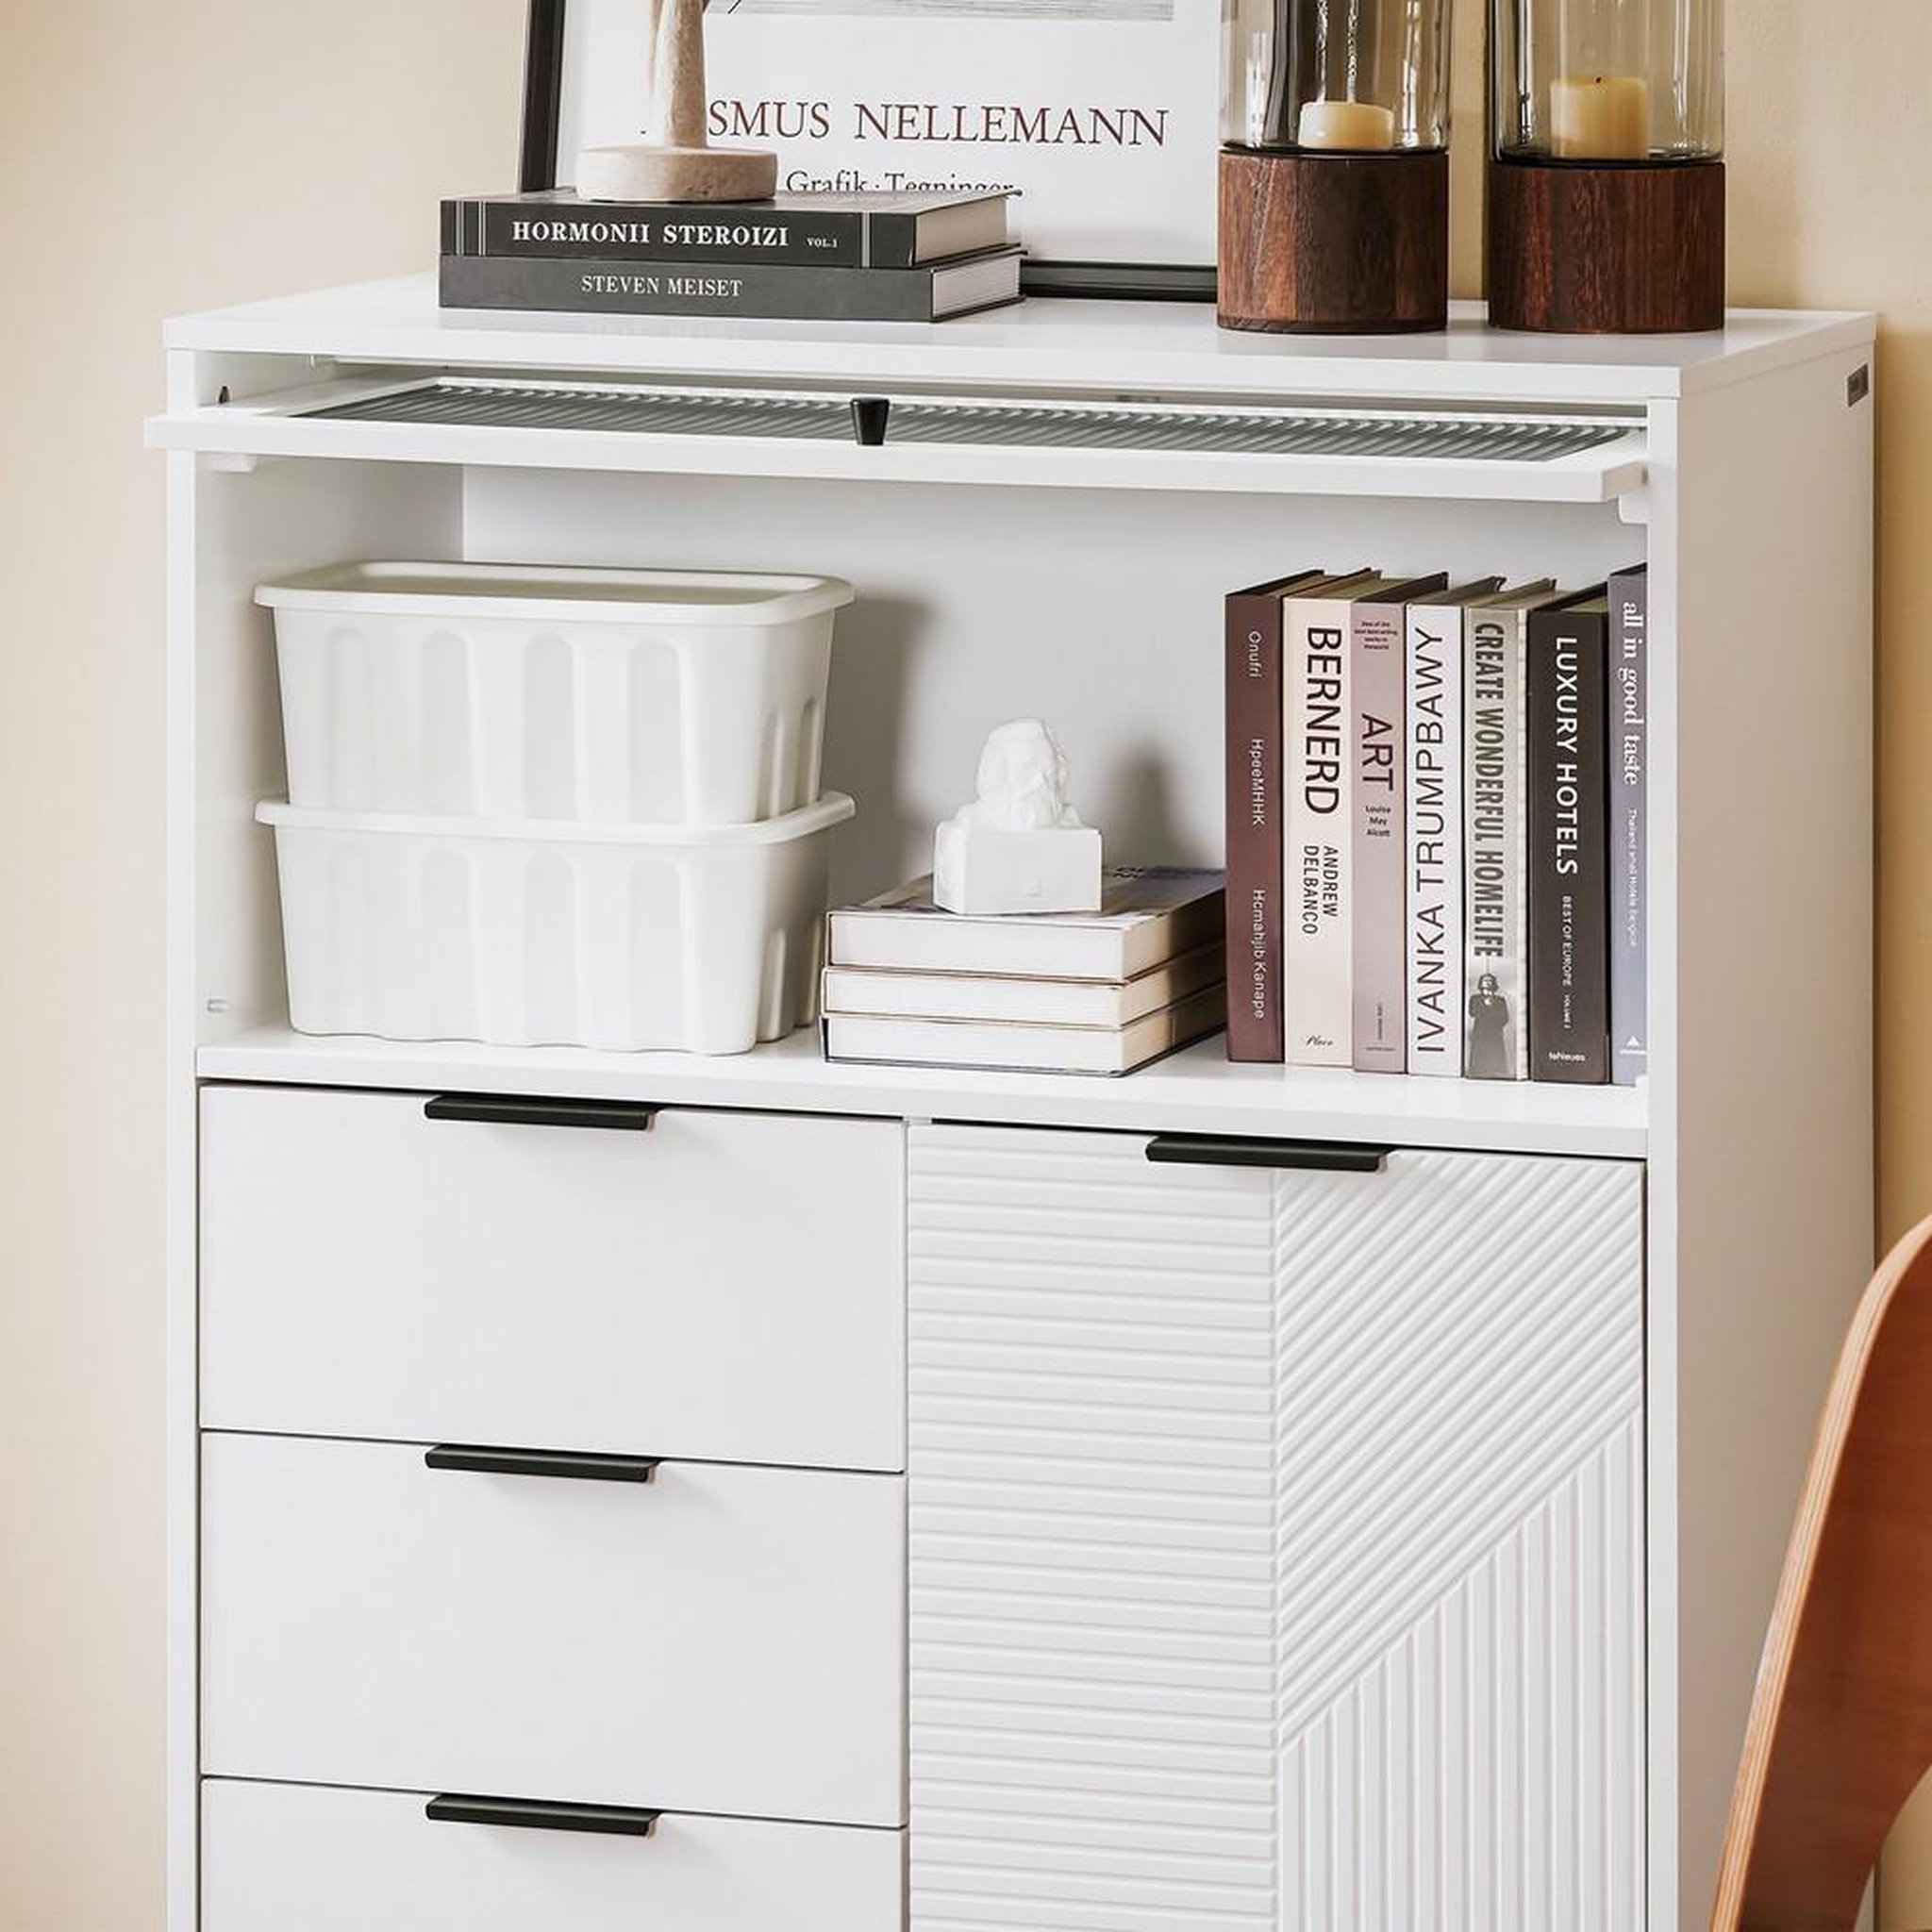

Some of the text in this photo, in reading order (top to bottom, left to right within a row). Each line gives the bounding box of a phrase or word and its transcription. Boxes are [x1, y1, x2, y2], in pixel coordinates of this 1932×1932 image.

[708, 100, 1169, 146] SMUS NELLEMANN
[786, 169, 867, 191] Grafik
[512, 221, 649, 243] HORMONII
[663, 225, 788, 246] STEROIZI
[581, 275, 742, 296] STEVEN MEISET
[1248, 630, 1262, 677] Onufri
[1305, 627, 1342, 814] BERNERD
[1618, 602, 1644, 785] all in good taste
[1361, 713, 1393, 791] ART
[1556, 637, 1578, 874] LUXURY HOTELS
[1474, 623, 1505, 958] CREATE WONDERFUL HOMELIFE
[1414, 626, 1445, 1052] IVANKA TRUMPBAWY
[1302, 845, 1320, 934] DELBANCO
[1323, 845, 1339, 917] ANDREW
[1562, 895, 1572, 924] BEST
[1562, 924, 1573, 940] OF
[1562, 941, 1573, 986] EUROPE
